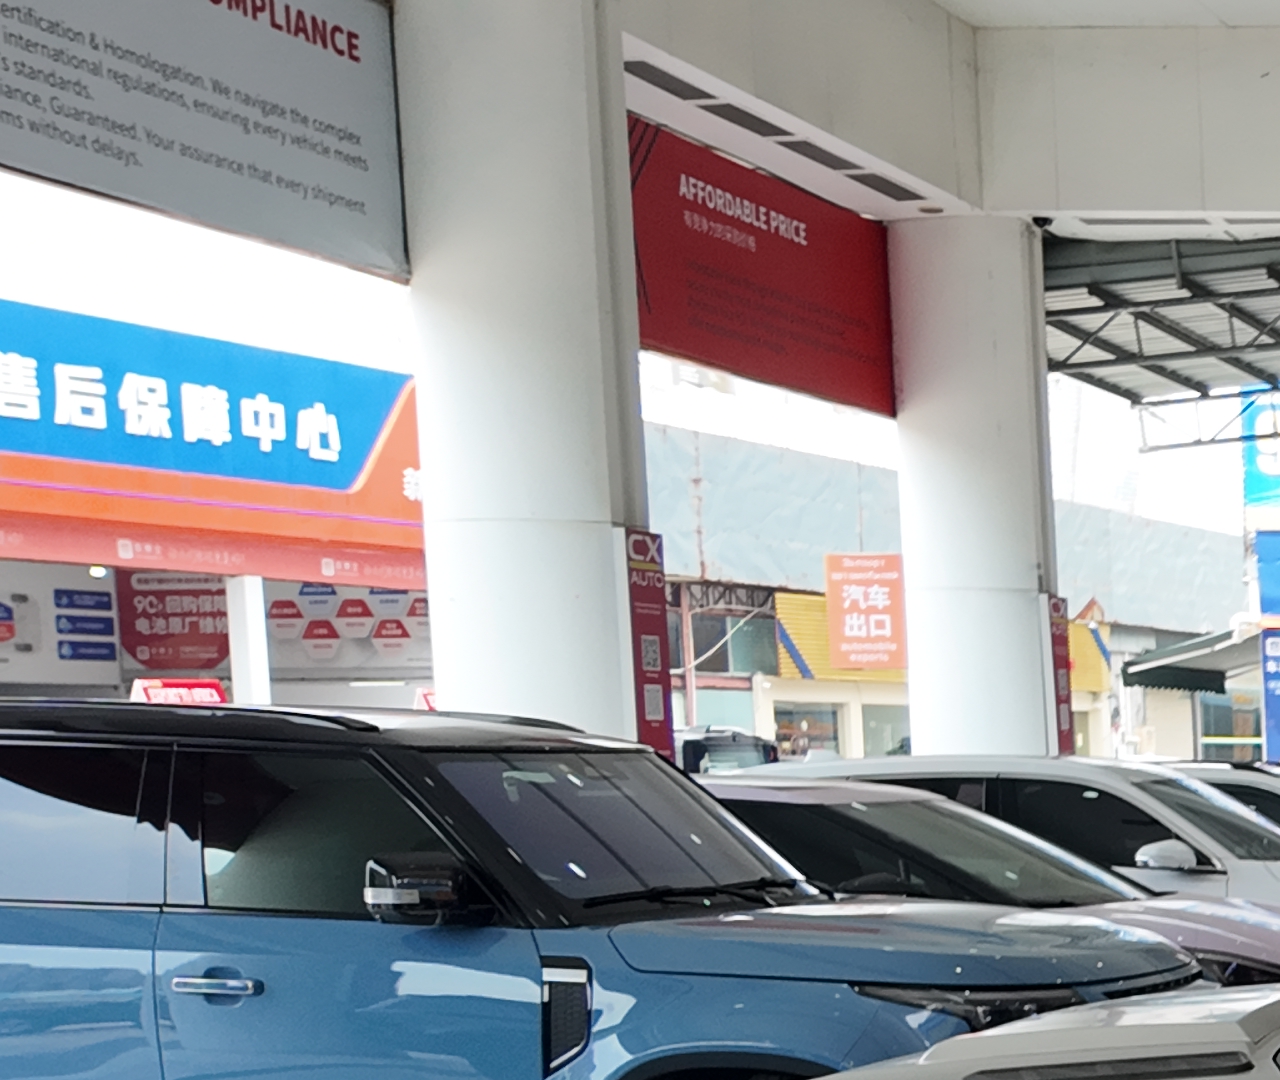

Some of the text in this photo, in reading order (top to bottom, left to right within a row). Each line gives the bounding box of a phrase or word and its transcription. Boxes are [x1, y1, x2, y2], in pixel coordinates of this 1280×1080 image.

[89, 31, 100, 51] &
[210, 77, 231, 99] We
[234, 90, 287, 119] navigate
[290, 107, 309, 128] the
[312, 118, 362, 146] complex
[27, 117, 88, 150] without
[50, 96, 142, 142] Guaranteed.
[143, 125, 174, 151] Your
[179, 142, 244, 176] assurance
[247, 163, 274, 186] that
[275, 174, 310, 201] every
[193, 99, 251, 134] ensuring
[253, 121, 286, 146] every
[290, 133, 331, 158] vehicle
[334, 149, 369, 172] meets
[679, 173, 768, 230] AFFORDABLE
[770, 209, 808, 246] PRICE
[0, 351, 342, 462] 售后保障中心
[628, 534, 662, 563] CX
[631, 571, 665, 588] AUTO
[842, 584, 891, 610] 汽车
[844, 612, 892, 638] 出口
